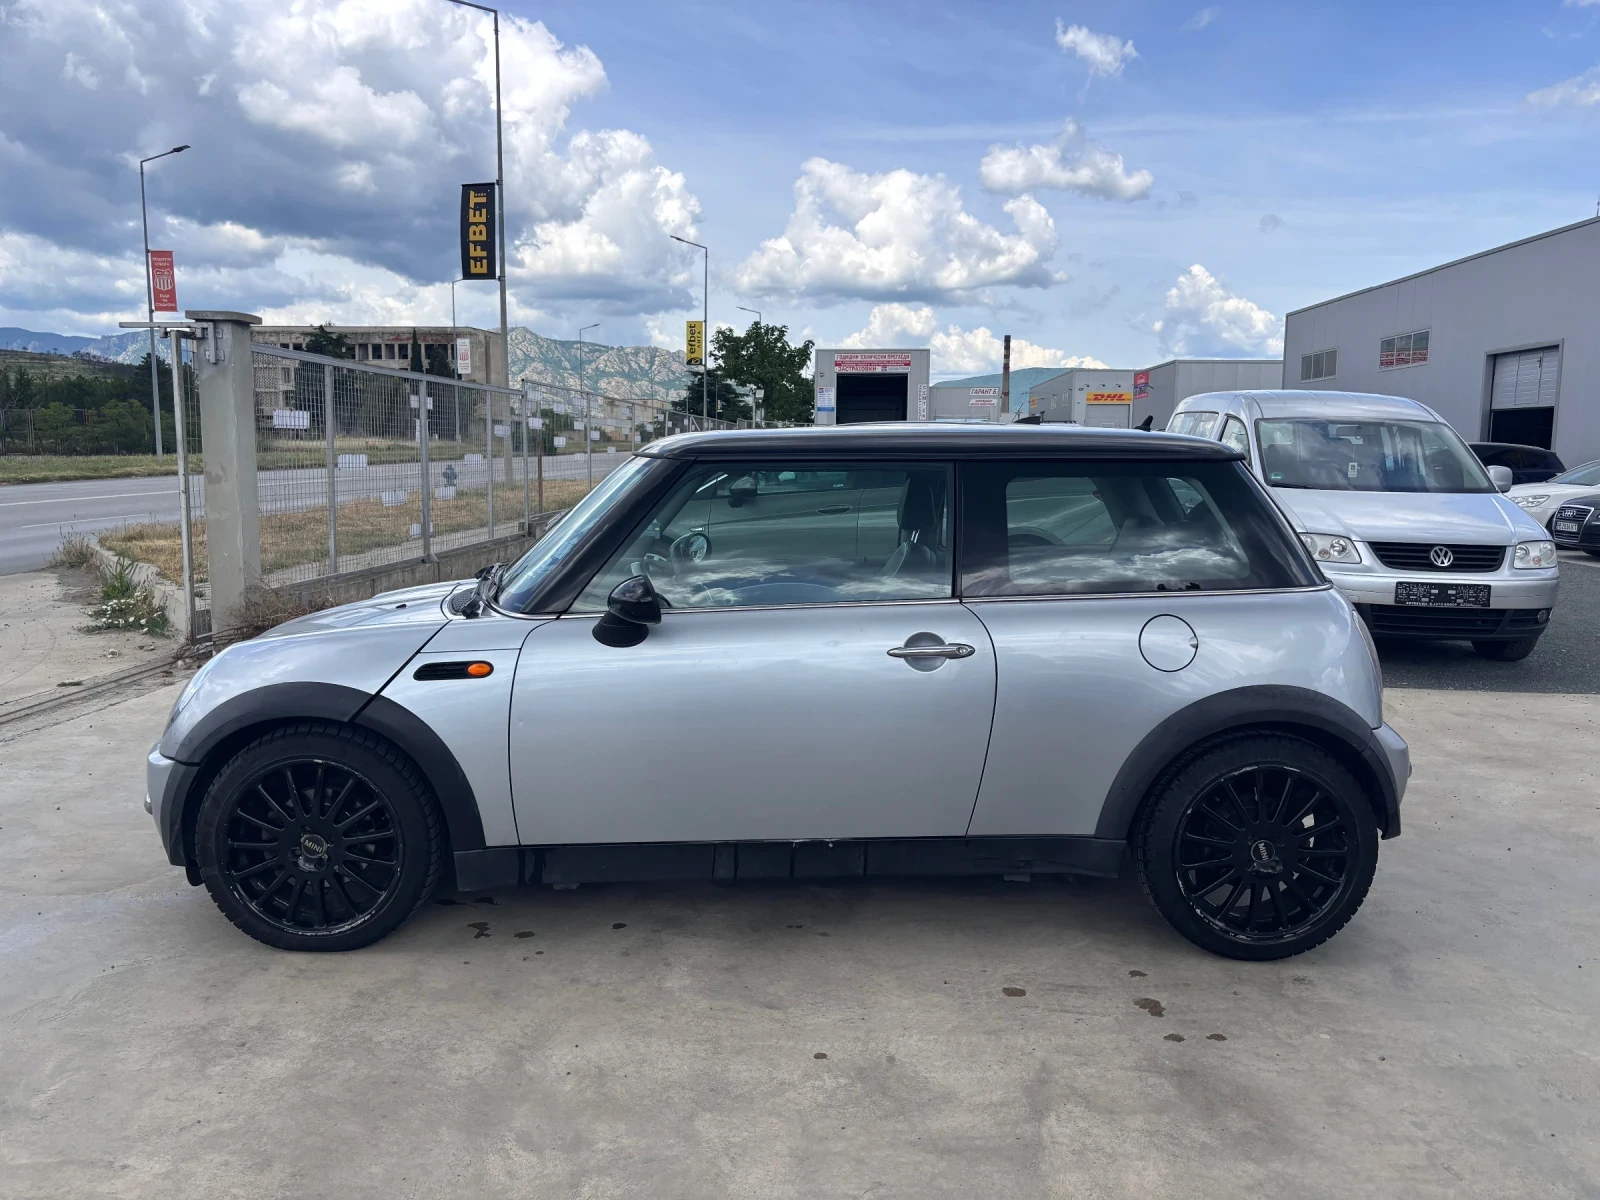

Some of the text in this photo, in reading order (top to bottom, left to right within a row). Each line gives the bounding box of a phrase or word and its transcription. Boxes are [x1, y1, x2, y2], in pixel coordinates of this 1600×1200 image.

[469, 190, 488, 274] EFBET
[1093, 393, 1126, 402] DHL
[304, 839, 323, 853] MINI
[1257, 842, 1269, 861] MINI
